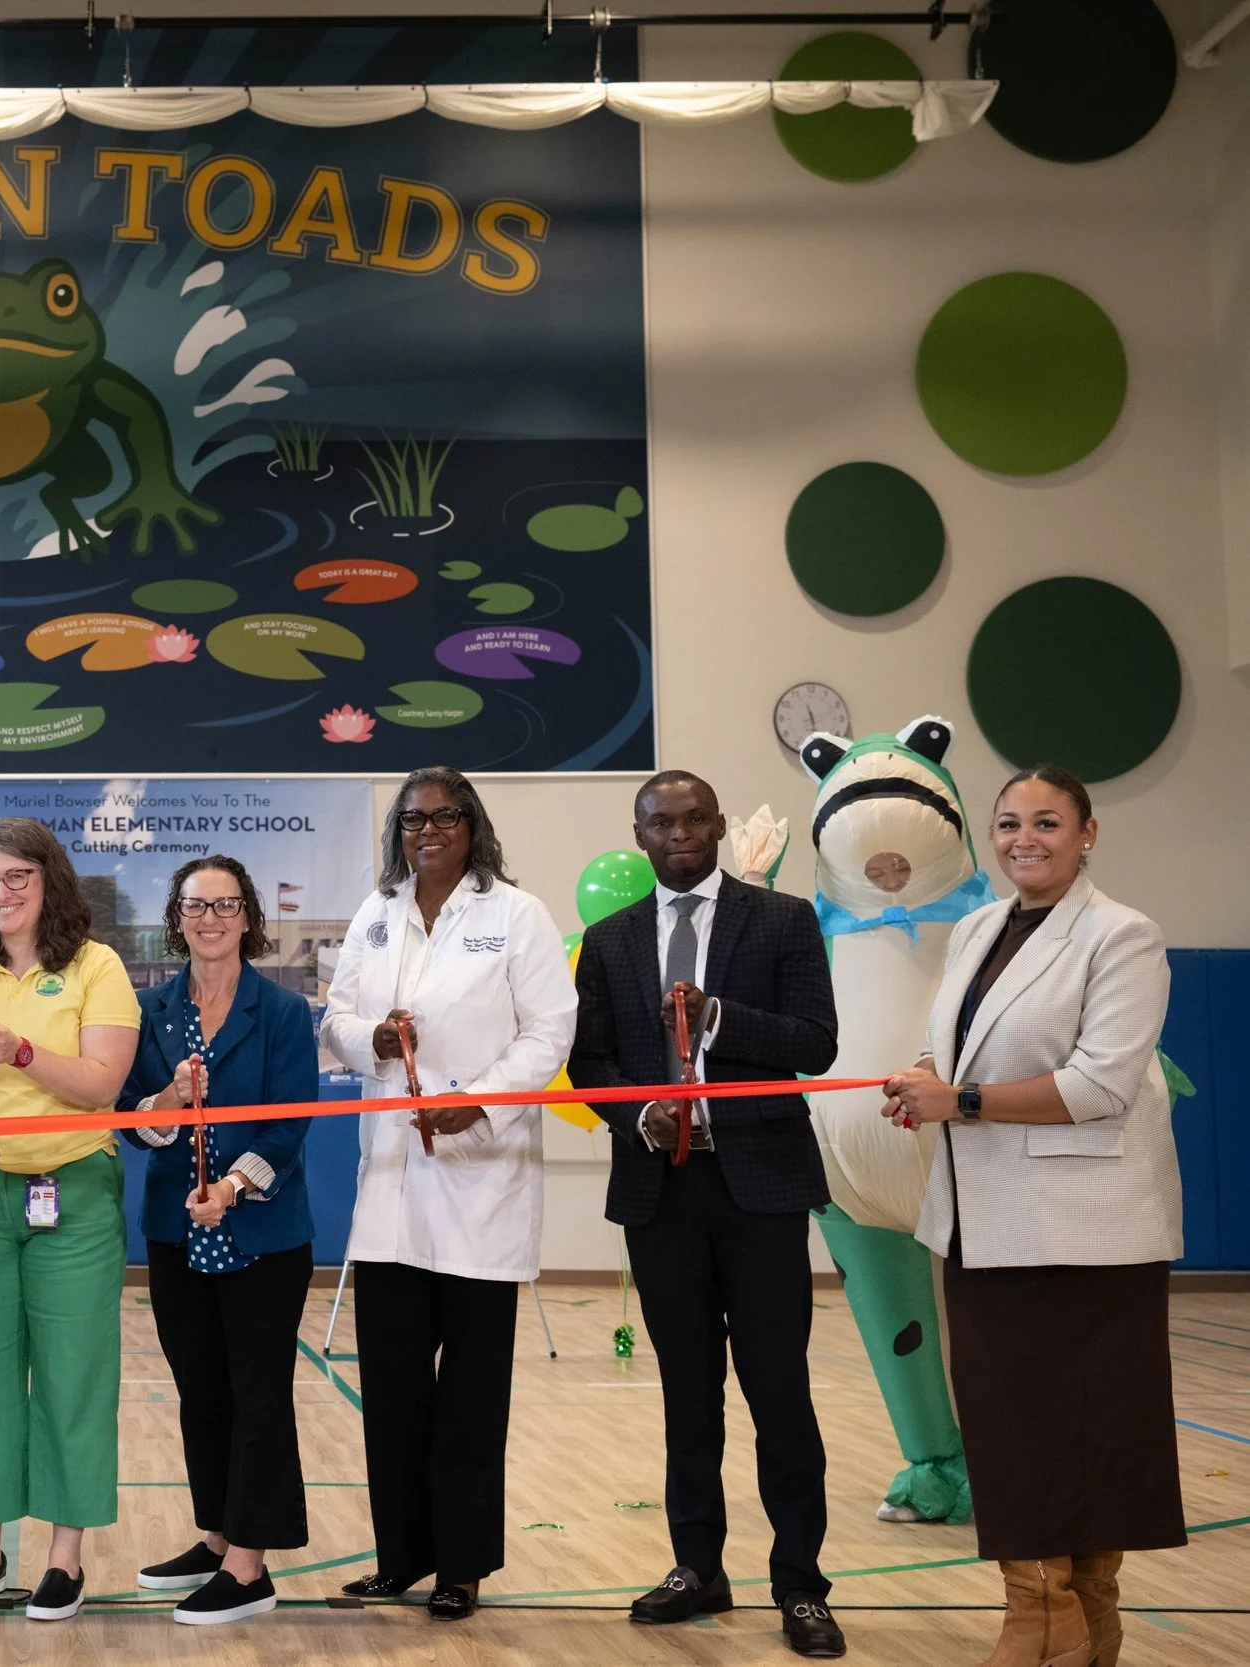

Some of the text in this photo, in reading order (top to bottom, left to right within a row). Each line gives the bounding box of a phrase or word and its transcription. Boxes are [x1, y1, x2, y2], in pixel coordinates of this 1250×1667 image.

[94, 147, 549, 296] TOADS
[318, 570, 342, 578] TODAY
[382, 570, 398, 578] DAY
[40, 626, 54, 635] WILL
[58, 621, 78, 630] HAVE
[64, 628, 88, 637] ABOUT
[282, 621, 318, 633] FOCUSED
[285, 630, 306, 639] WORK
[476, 633, 495, 641] AND
[519, 632, 539, 641] HERE
[465, 643, 482, 652] AND
[484, 641, 510, 649] READY
[525, 642, 551, 652] LEARN
[17, 724, 51, 735] RESPECT
[53, 714, 83, 730] MYSELF
[20, 725, 84, 744] ENVIRONMENT
[4, 794, 50, 808] Muriel
[55, 794, 106, 808] Bowser
[112, 794, 187, 808] Welcomes
[191, 794, 218, 808] You
[222, 794, 239, 808] To
[244, 794, 271, 808] The
[91, 817, 223, 832] ELEMENTARY
[228, 816, 316, 832] SCHOOL
[71, 840, 128, 856] Cutting
[132, 840, 210, 856] Ceremony
